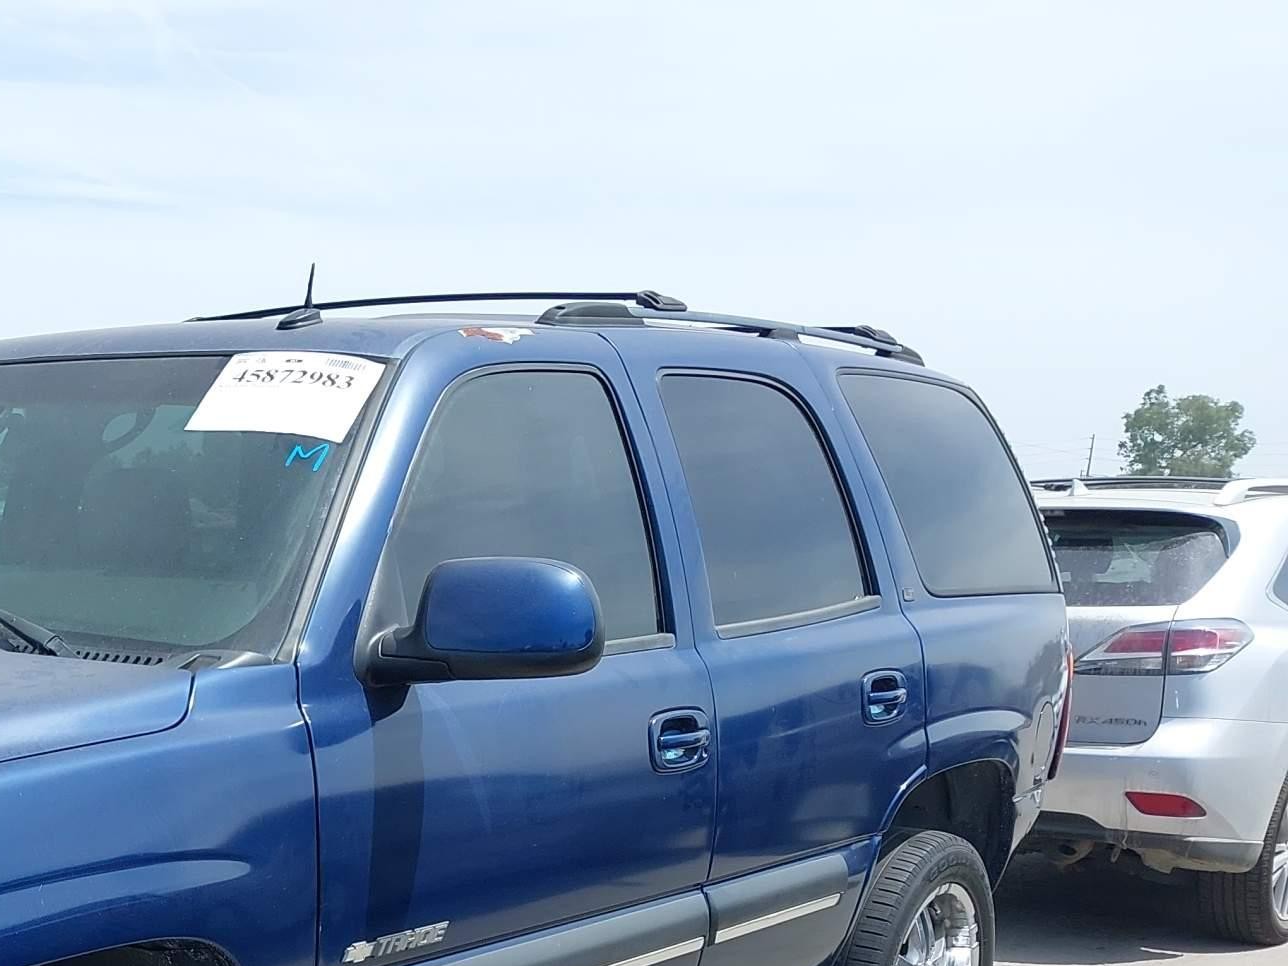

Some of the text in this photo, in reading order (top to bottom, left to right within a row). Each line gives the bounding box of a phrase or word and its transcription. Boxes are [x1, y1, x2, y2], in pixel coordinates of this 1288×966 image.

[231, 368, 356, 390] 45872983
[285, 443, 330, 473] M
[375, 920, 451, 957] TAHOE
